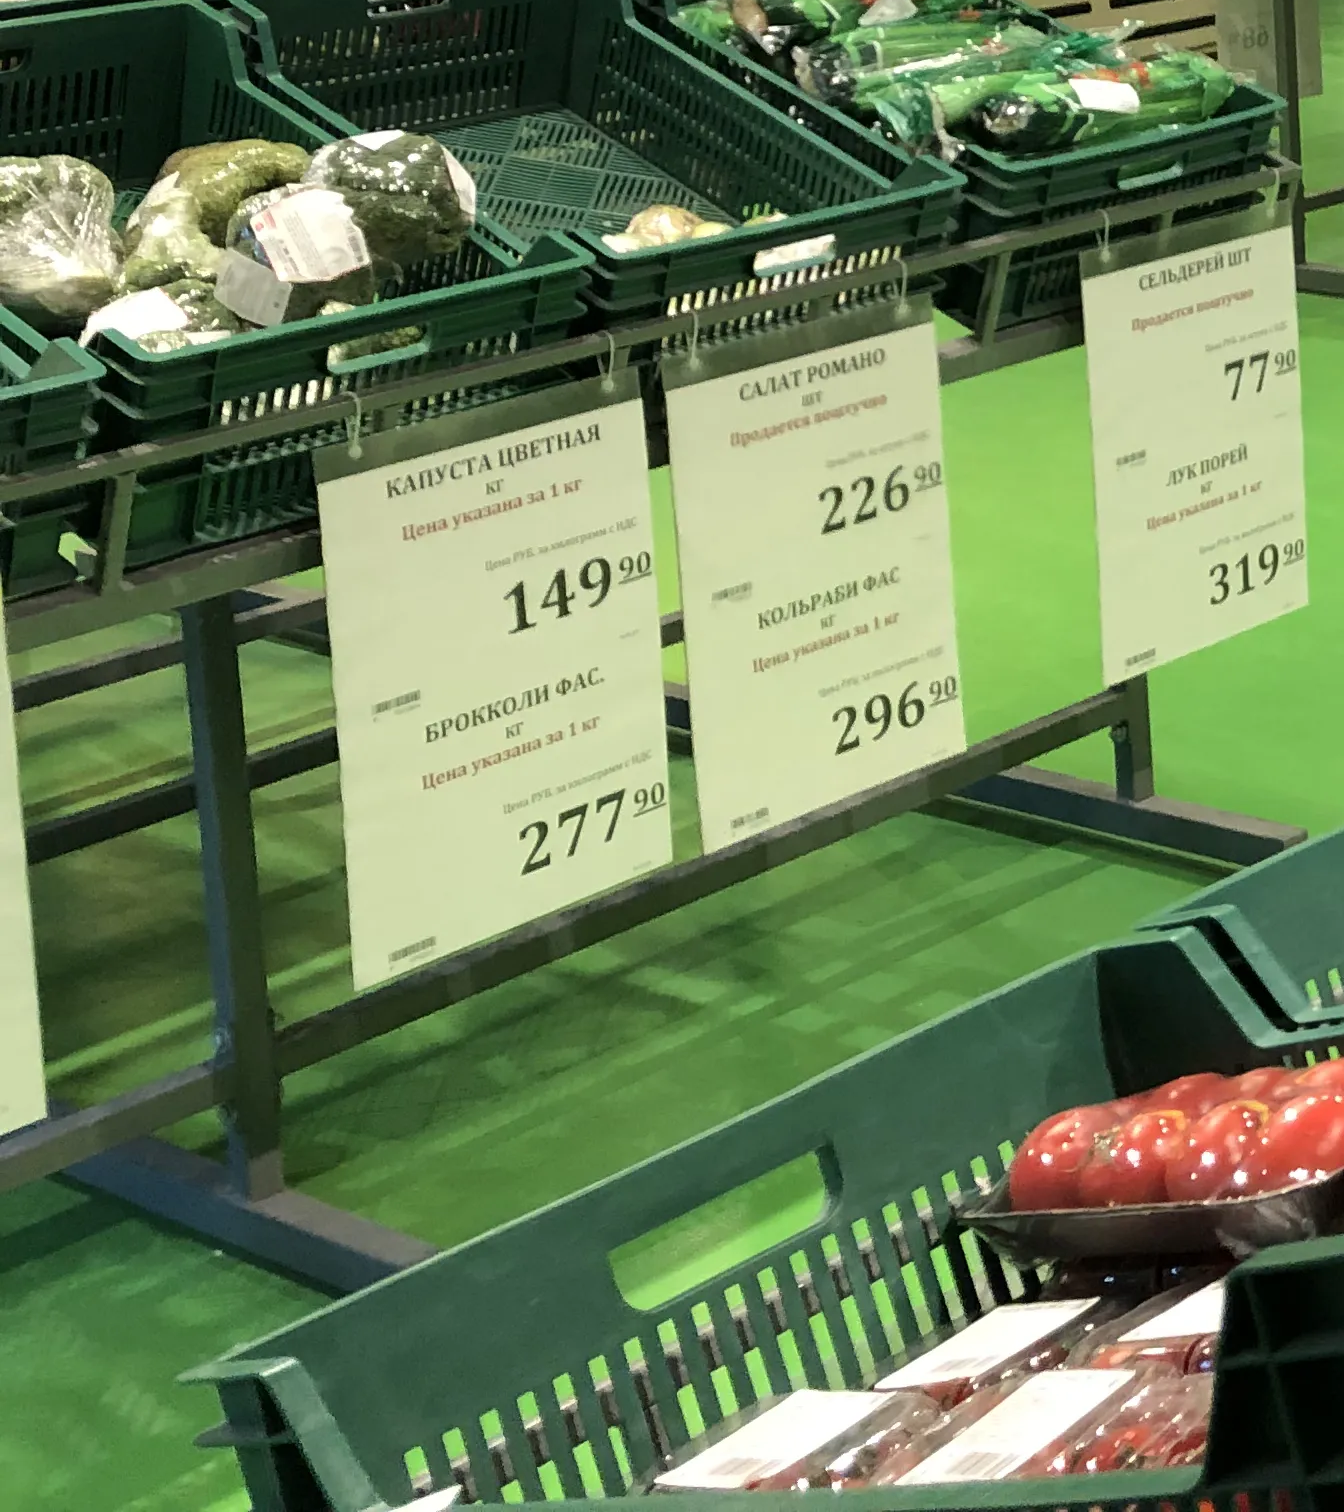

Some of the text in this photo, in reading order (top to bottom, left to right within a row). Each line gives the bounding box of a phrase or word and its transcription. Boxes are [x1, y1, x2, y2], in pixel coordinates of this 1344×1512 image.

[1139, 247, 1252, 292] СЕЛЬДЕРЕЙ ШТ
[1131, 305, 1194, 333] Продается
[739, 348, 886, 401] САЛАТ РОМАНО
[1224, 350, 1270, 401] 77
[730, 415, 810, 448] Продается
[386, 423, 601, 499] КАПУСТА ЦВЕТНАЯ
[485, 479, 504, 495] кг
[1165, 442, 1248, 487] ЛУК ПОРЕЙ
[402, 479, 583, 541] Цена указана за 1 кг
[819, 465, 911, 534] 226
[1146, 512, 1176, 531] Цена
[503, 556, 613, 635] 149
[757, 566, 900, 630] КОЛЬРАБИ ФАС
[1209, 543, 1280, 606] 319
[753, 652, 790, 673] Цена
[793, 630, 850, 663] указана
[853, 623, 869, 637] за
[425, 666, 605, 744] БРОККОЛИ ФАС.
[505, 721, 524, 739] кг
[832, 681, 925, 756] 296
[422, 716, 601, 790] Цена указана за 1 кг
[519, 789, 627, 877] 277
